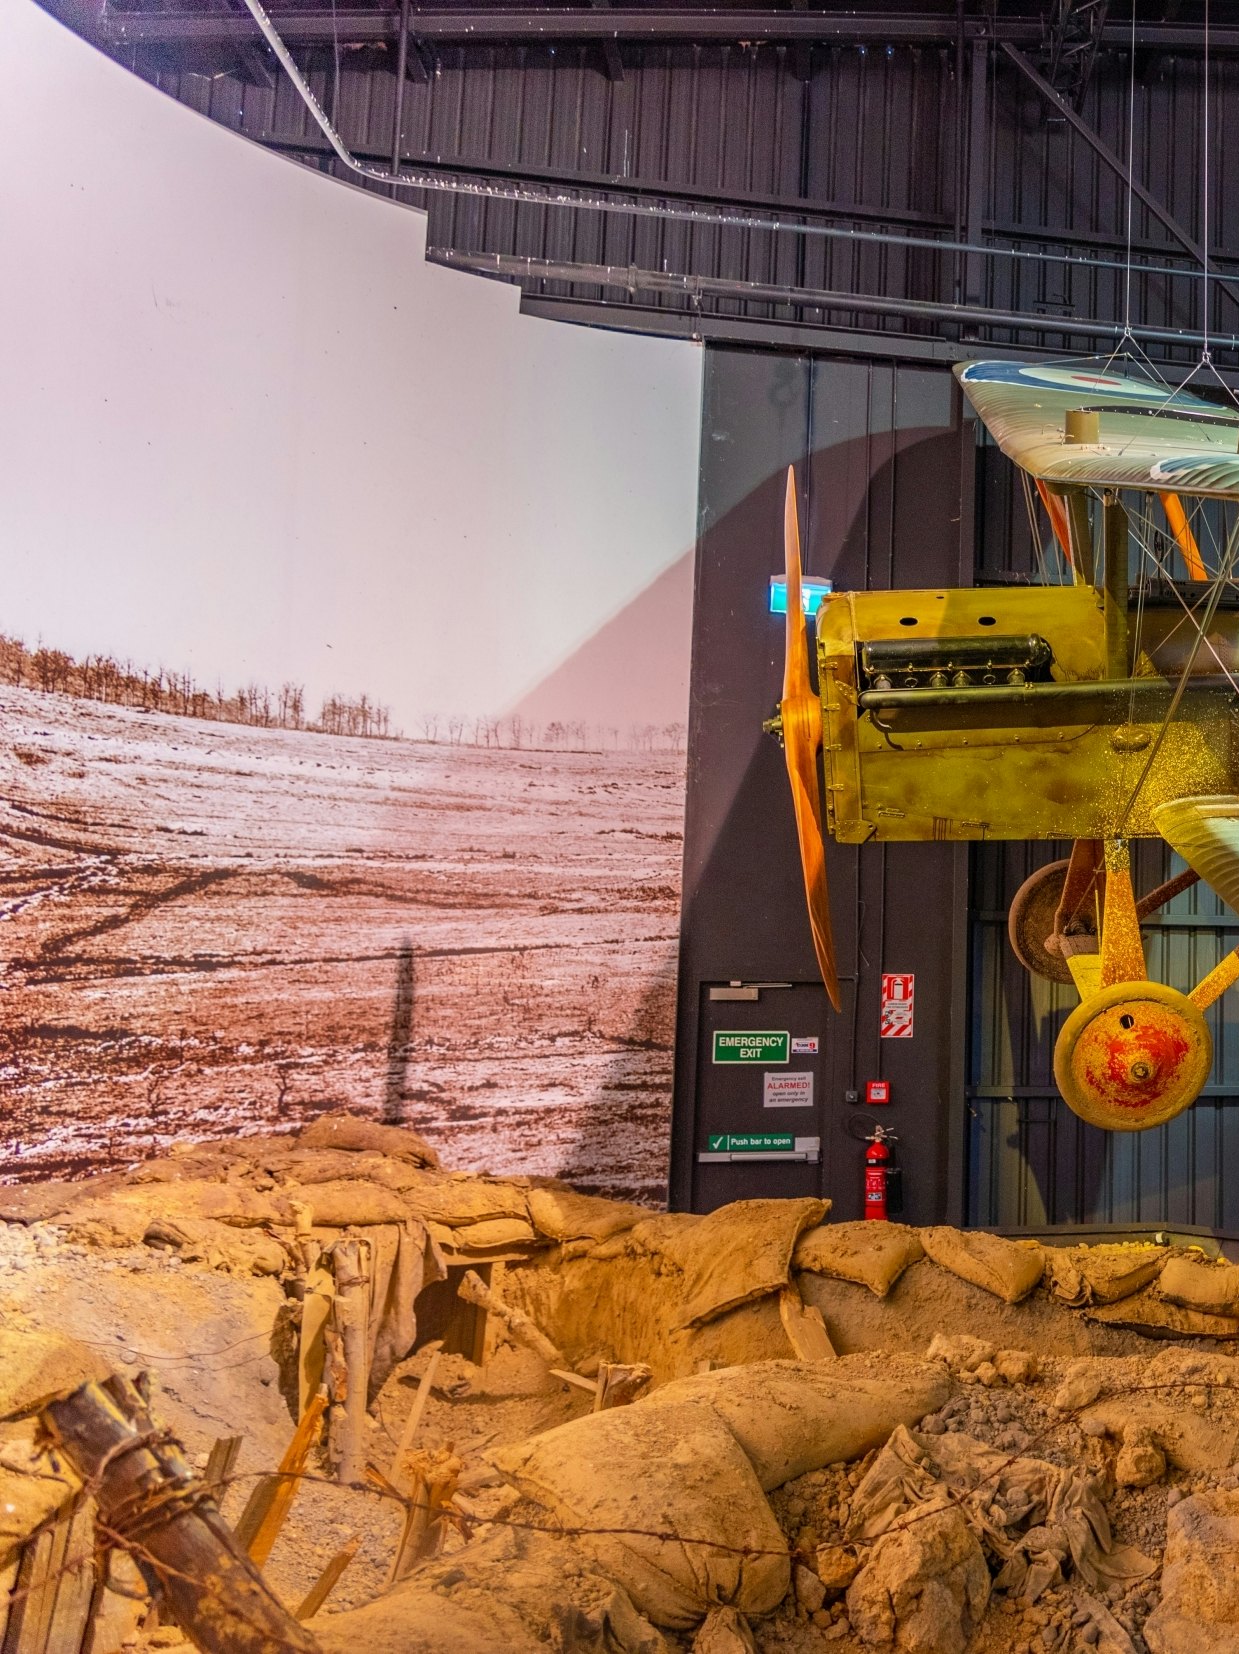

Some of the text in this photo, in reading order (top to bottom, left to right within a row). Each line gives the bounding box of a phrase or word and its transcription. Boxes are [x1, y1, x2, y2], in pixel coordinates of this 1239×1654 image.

[718, 1036, 784, 1047] EMERGENCY
[740, 1048, 762, 1058] EXIT
[767, 1081, 811, 1090] ALARMED!
[730, 1137, 791, 1147] Push bar to open
